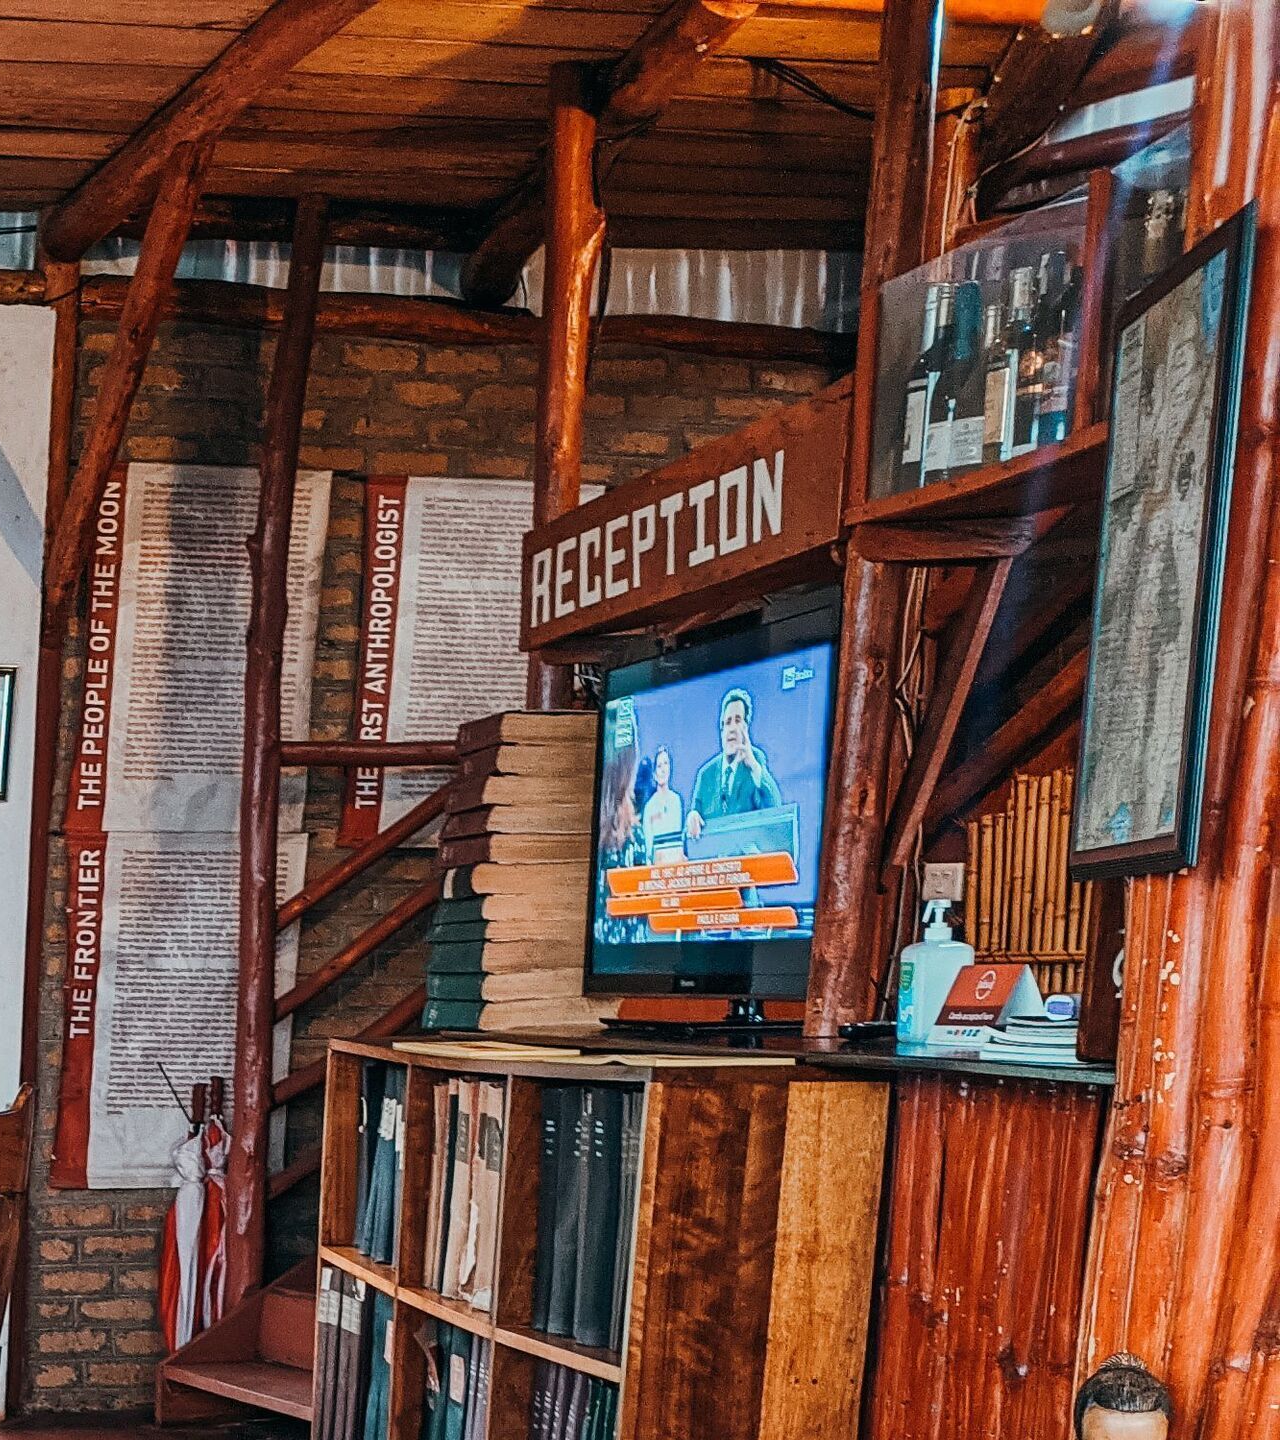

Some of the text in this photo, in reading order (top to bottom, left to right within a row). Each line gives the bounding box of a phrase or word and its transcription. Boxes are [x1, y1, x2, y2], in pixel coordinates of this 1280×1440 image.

[364, 495, 401, 695] ANTHROPOLOGIST
[530, 449, 785, 629] RECEPTION
[77, 482, 121, 811] THE PEOPLE OF THE MOON
[354, 767, 379, 810] THE
[69, 850, 101, 1039] THE FRONTIER
